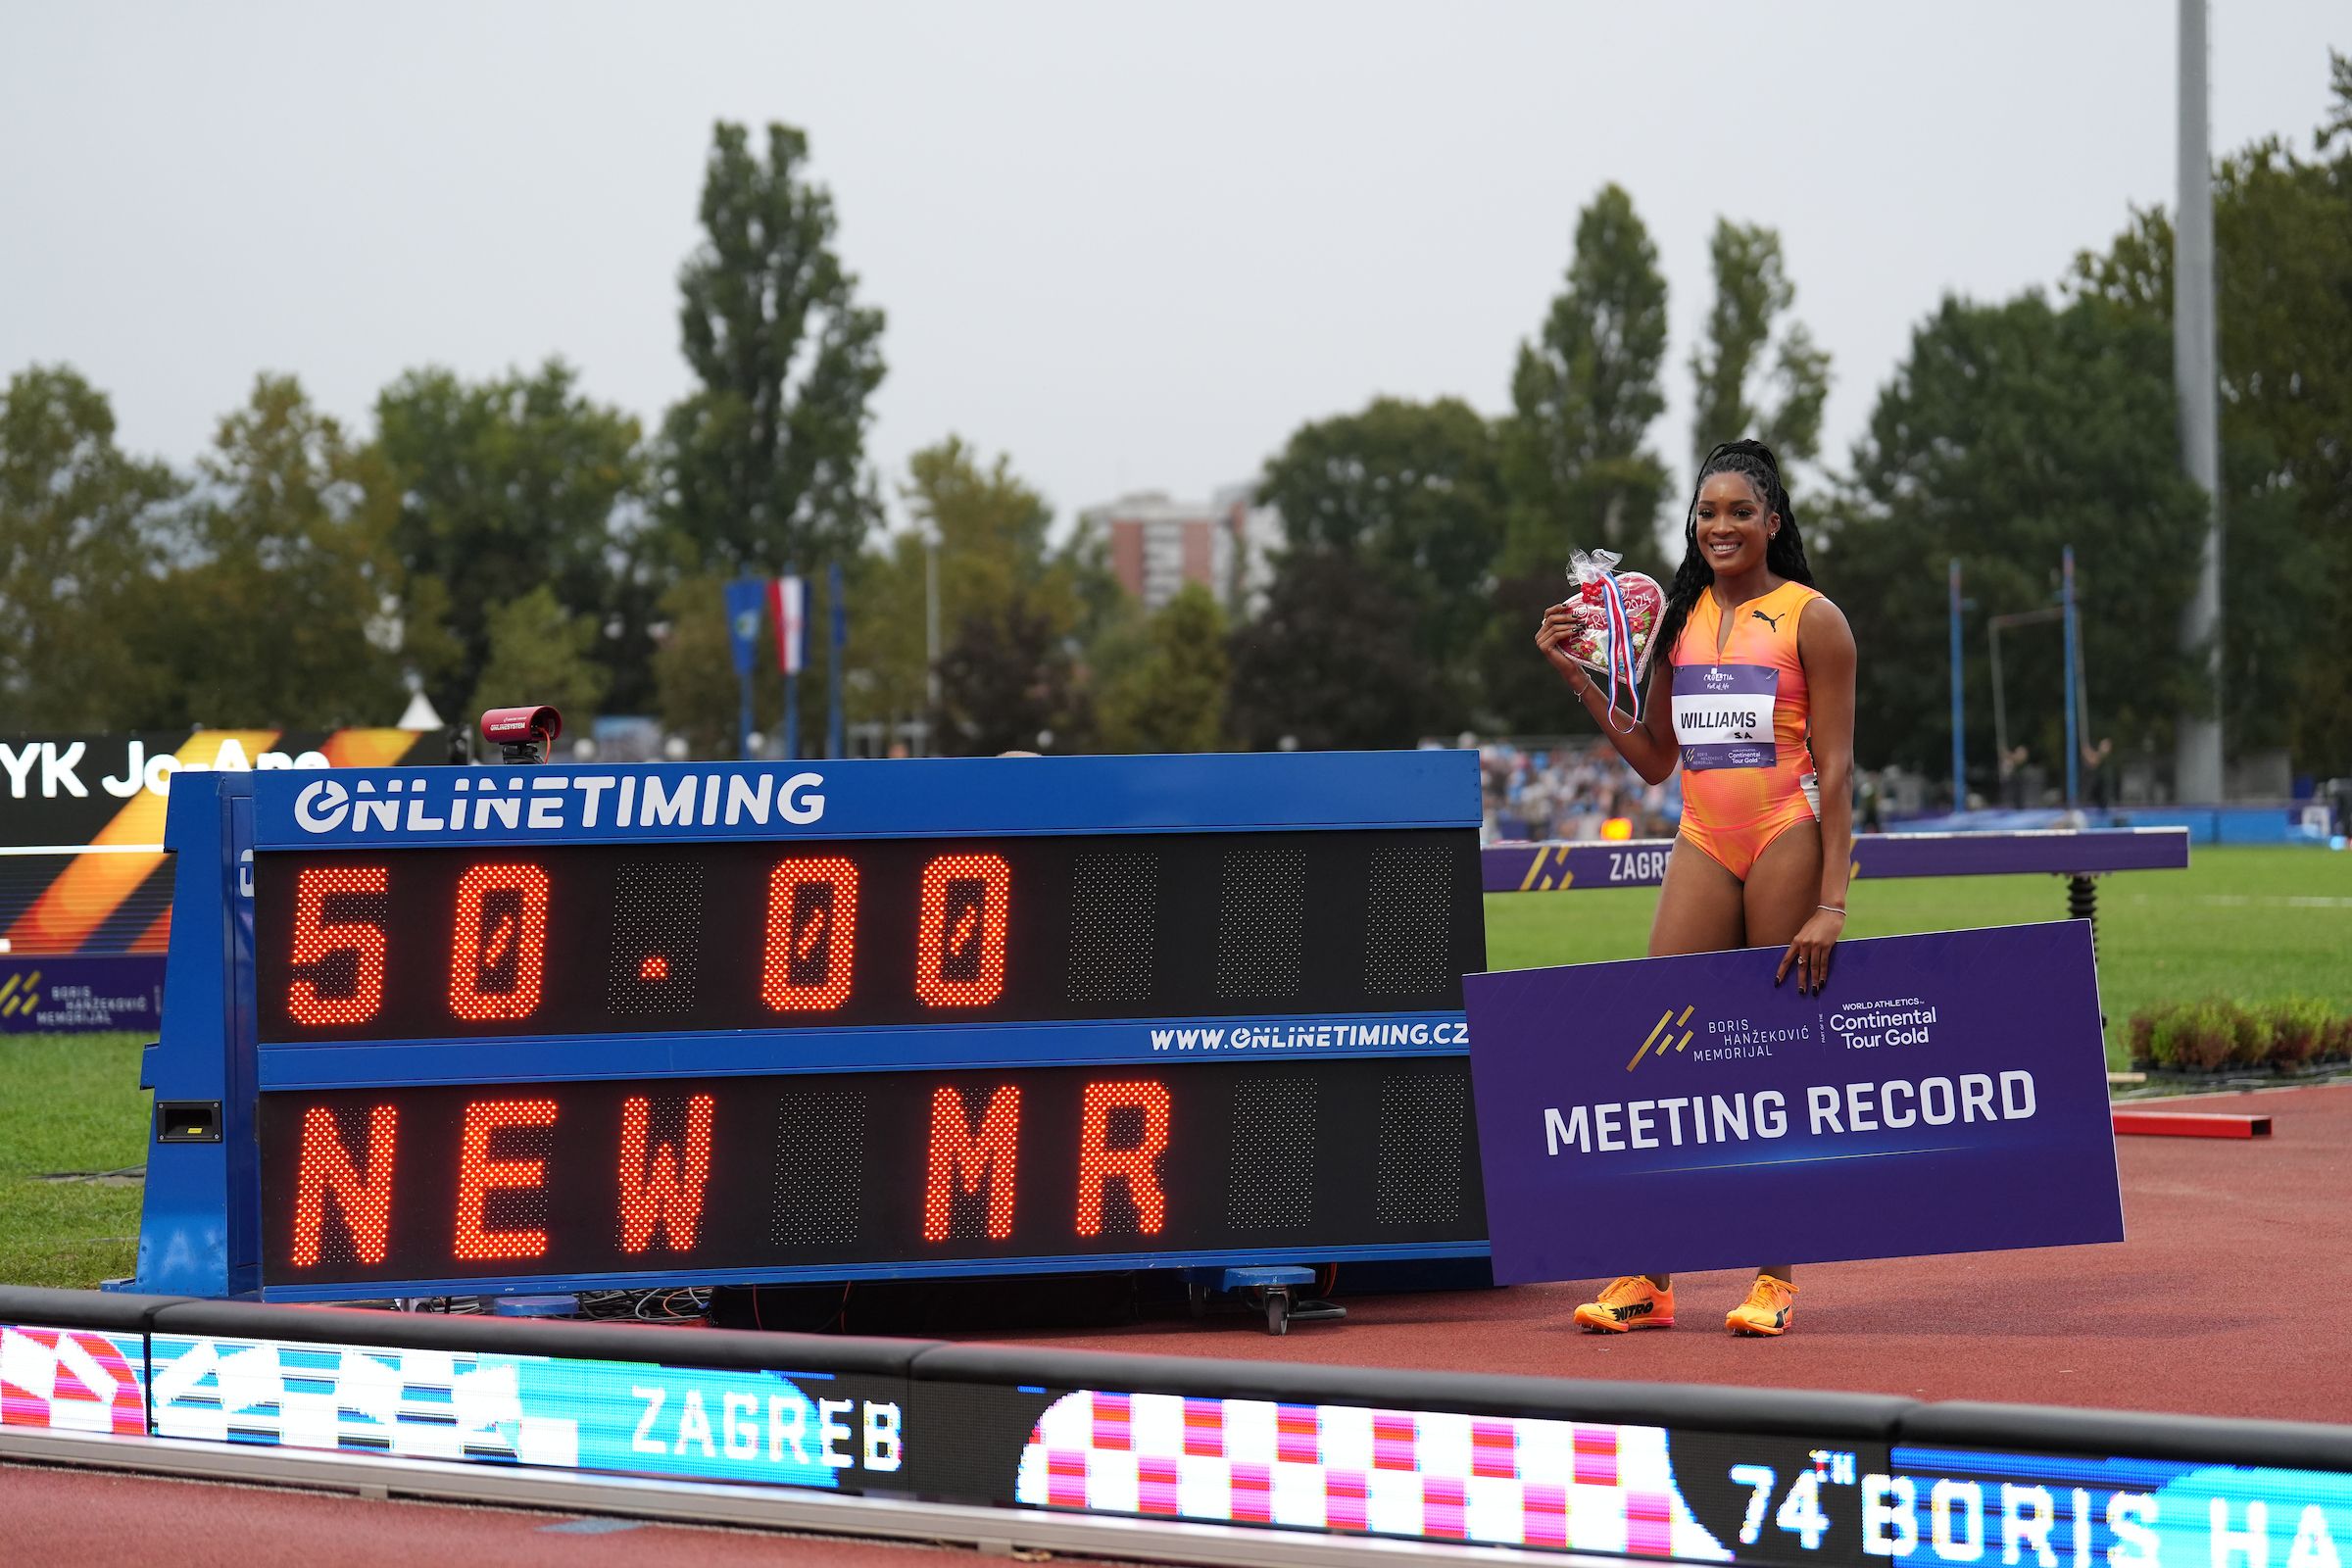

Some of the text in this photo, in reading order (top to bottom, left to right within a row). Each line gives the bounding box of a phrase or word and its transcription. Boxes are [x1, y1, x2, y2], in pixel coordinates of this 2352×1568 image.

[1681, 712, 1756, 729] WILLIAMS
[287, 853, 1011, 1026] 50.00
[1842, 998, 1920, 1010] WORLD ATHLETICS
[1708, 1019, 1749, 1034] BORIS
[1830, 1006, 1936, 1031] Continental
[1724, 1025, 1809, 1046] HANŽEKOVIĆ
[1840, 1026, 1930, 1050] Tour Gold
[1693, 1045, 1773, 1062] MEMORIJAL
[1544, 1070, 2036, 1156] MEETING RECORD
[292, 1080, 1170, 1267] NEW MR
[1614, 1301, 1654, 1321] NITRO
[631, 1382, 903, 1472] ZAGREB
[1862, 1473, 2160, 1568] BORIS
[2209, 1497, 2342, 1568] HA
